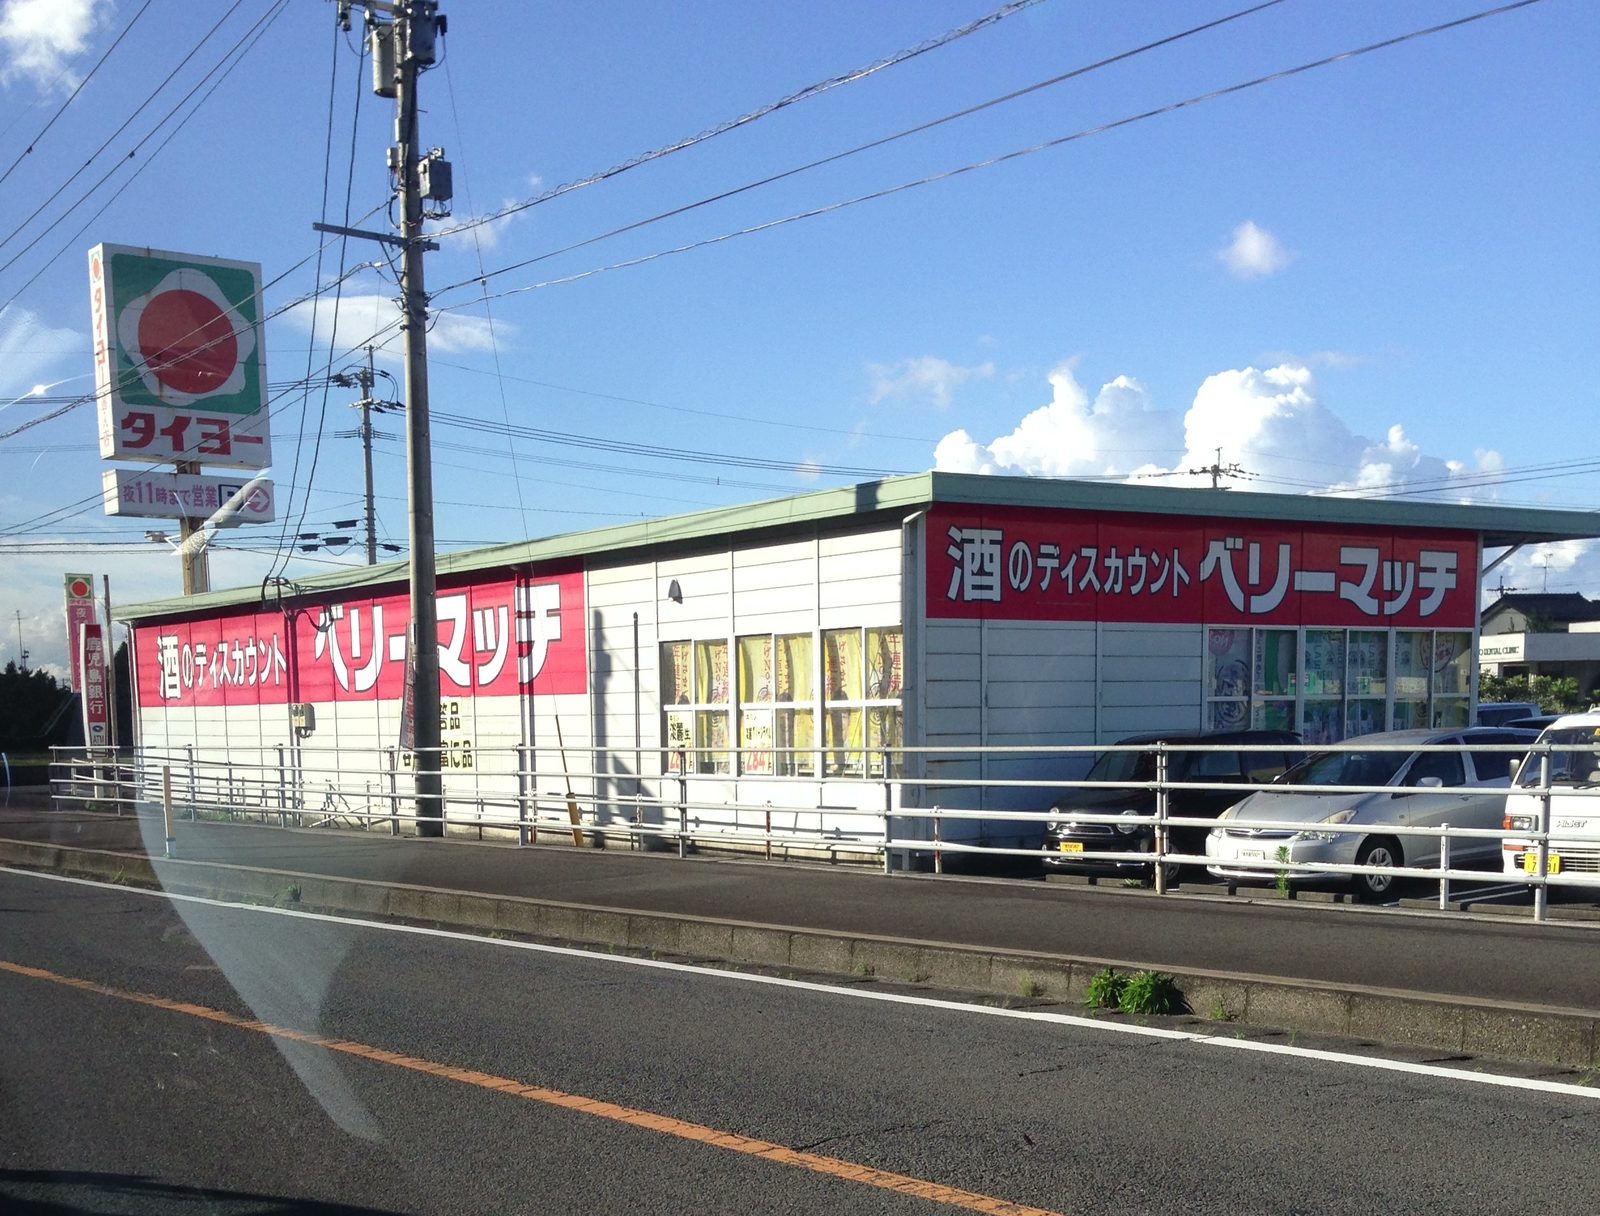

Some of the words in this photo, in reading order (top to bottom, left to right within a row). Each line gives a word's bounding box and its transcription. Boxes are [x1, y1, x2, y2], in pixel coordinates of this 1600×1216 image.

[120, 411, 264, 456] タイヨー
[123, 481, 218, 508] 夜11時まで営業
[945, 524, 1191, 603] 酒のディスカウント
[1199, 536, 1459, 618] ベリーマッチ
[86, 637, 104, 714] 鹿児島銀行
[157, 632, 287, 700] 酒のディスカウント
[314, 582, 562, 694] ベリーマッチ
